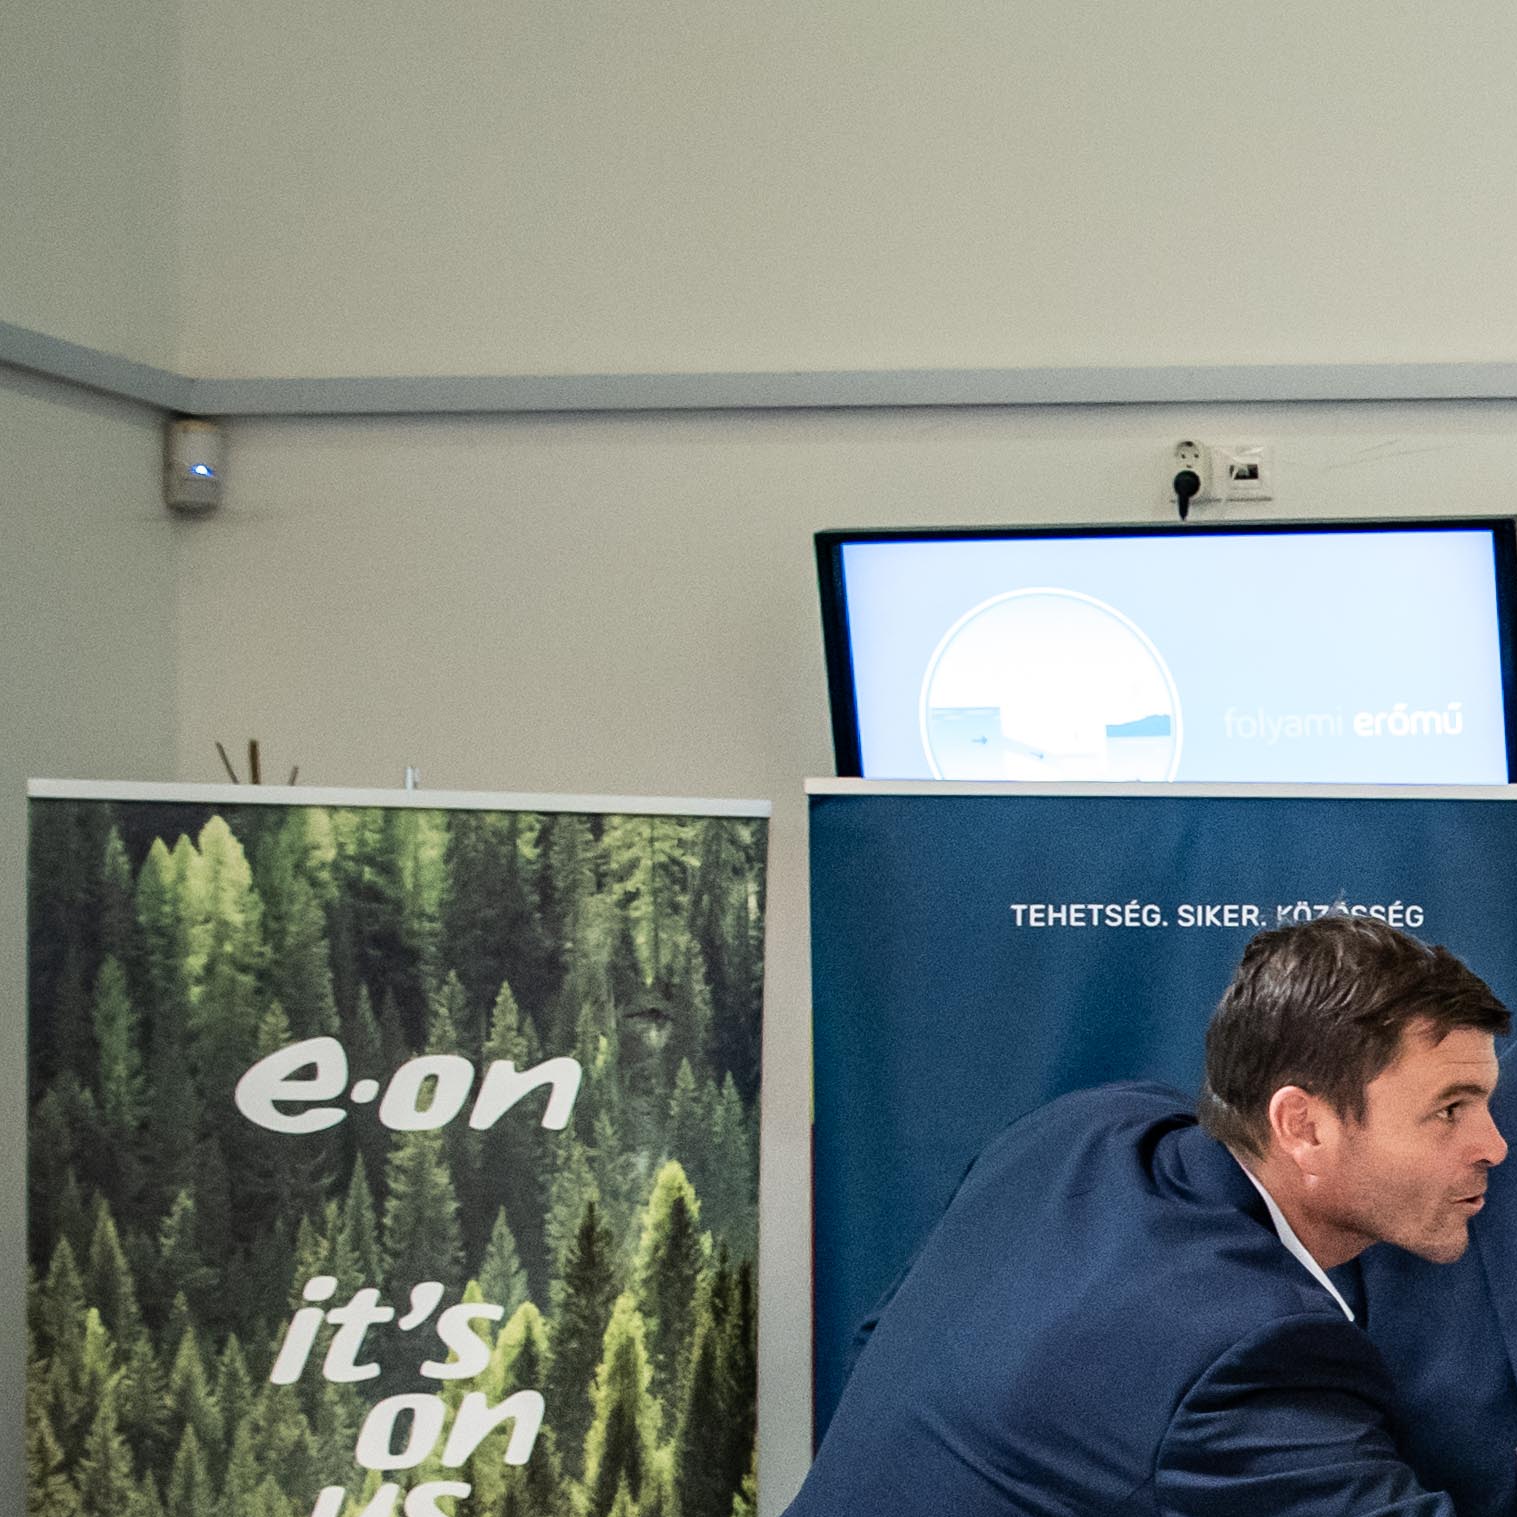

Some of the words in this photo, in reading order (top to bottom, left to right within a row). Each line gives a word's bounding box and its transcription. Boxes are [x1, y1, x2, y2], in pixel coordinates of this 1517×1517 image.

[1223, 706, 1344, 746] folyami
[1353, 701, 1463, 737] erőmű
[1010, 899, 1169, 927] TEHETSÉG.
[1177, 904, 1267, 927] SIKER.
[270, 1275, 505, 1385] it's
[355, 1390, 546, 1472] on
